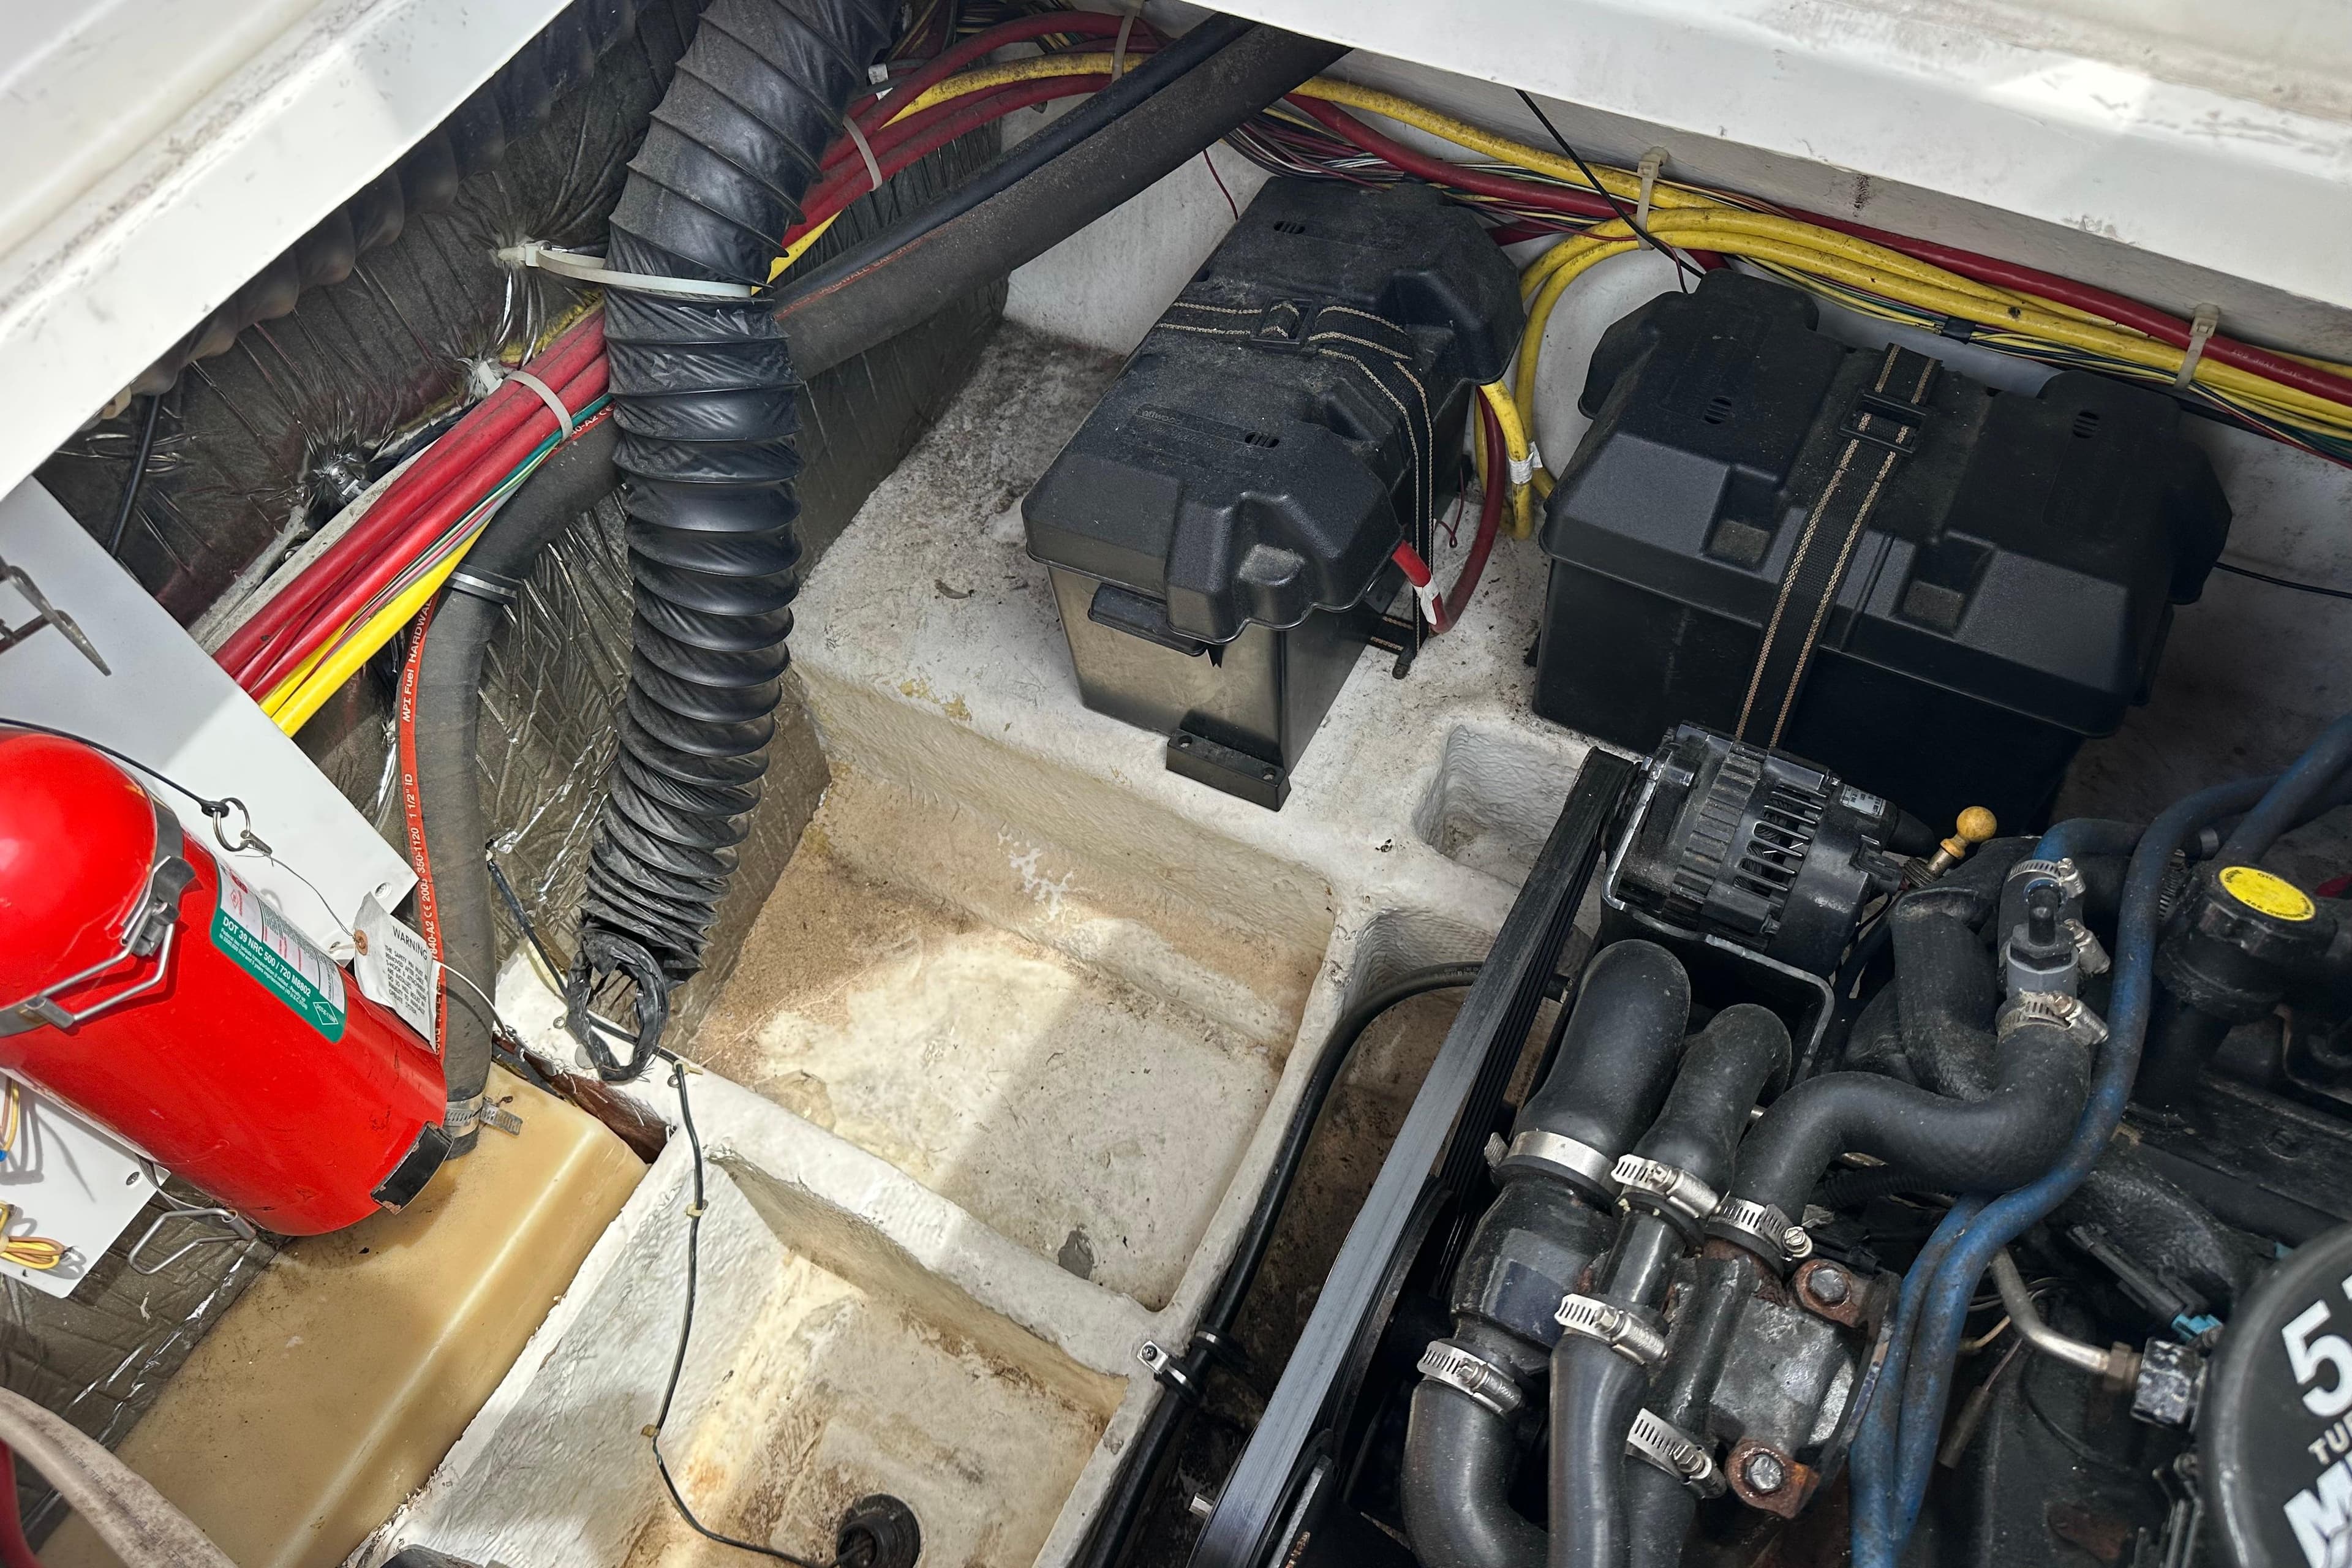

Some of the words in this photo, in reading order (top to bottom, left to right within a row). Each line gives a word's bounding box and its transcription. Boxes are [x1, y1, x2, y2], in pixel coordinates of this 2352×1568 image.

[408, 597, 434, 663] HARDWAL
[404, 669, 414, 695] Fuel
[402, 697, 412, 723] MPI
[404, 774, 413, 786] ID
[411, 827, 426, 874] 350-1120
[223, 916, 239, 935] DOT
[238, 930, 248, 943] 39
[247, 937, 264, 956] NRC
[263, 951, 276, 967] 500
[280, 964, 292, 980] 720
[291, 974, 311, 997] M8802
[393, 925, 428, 960] WARNING
[2308, 1410, 2352, 1465] TU
